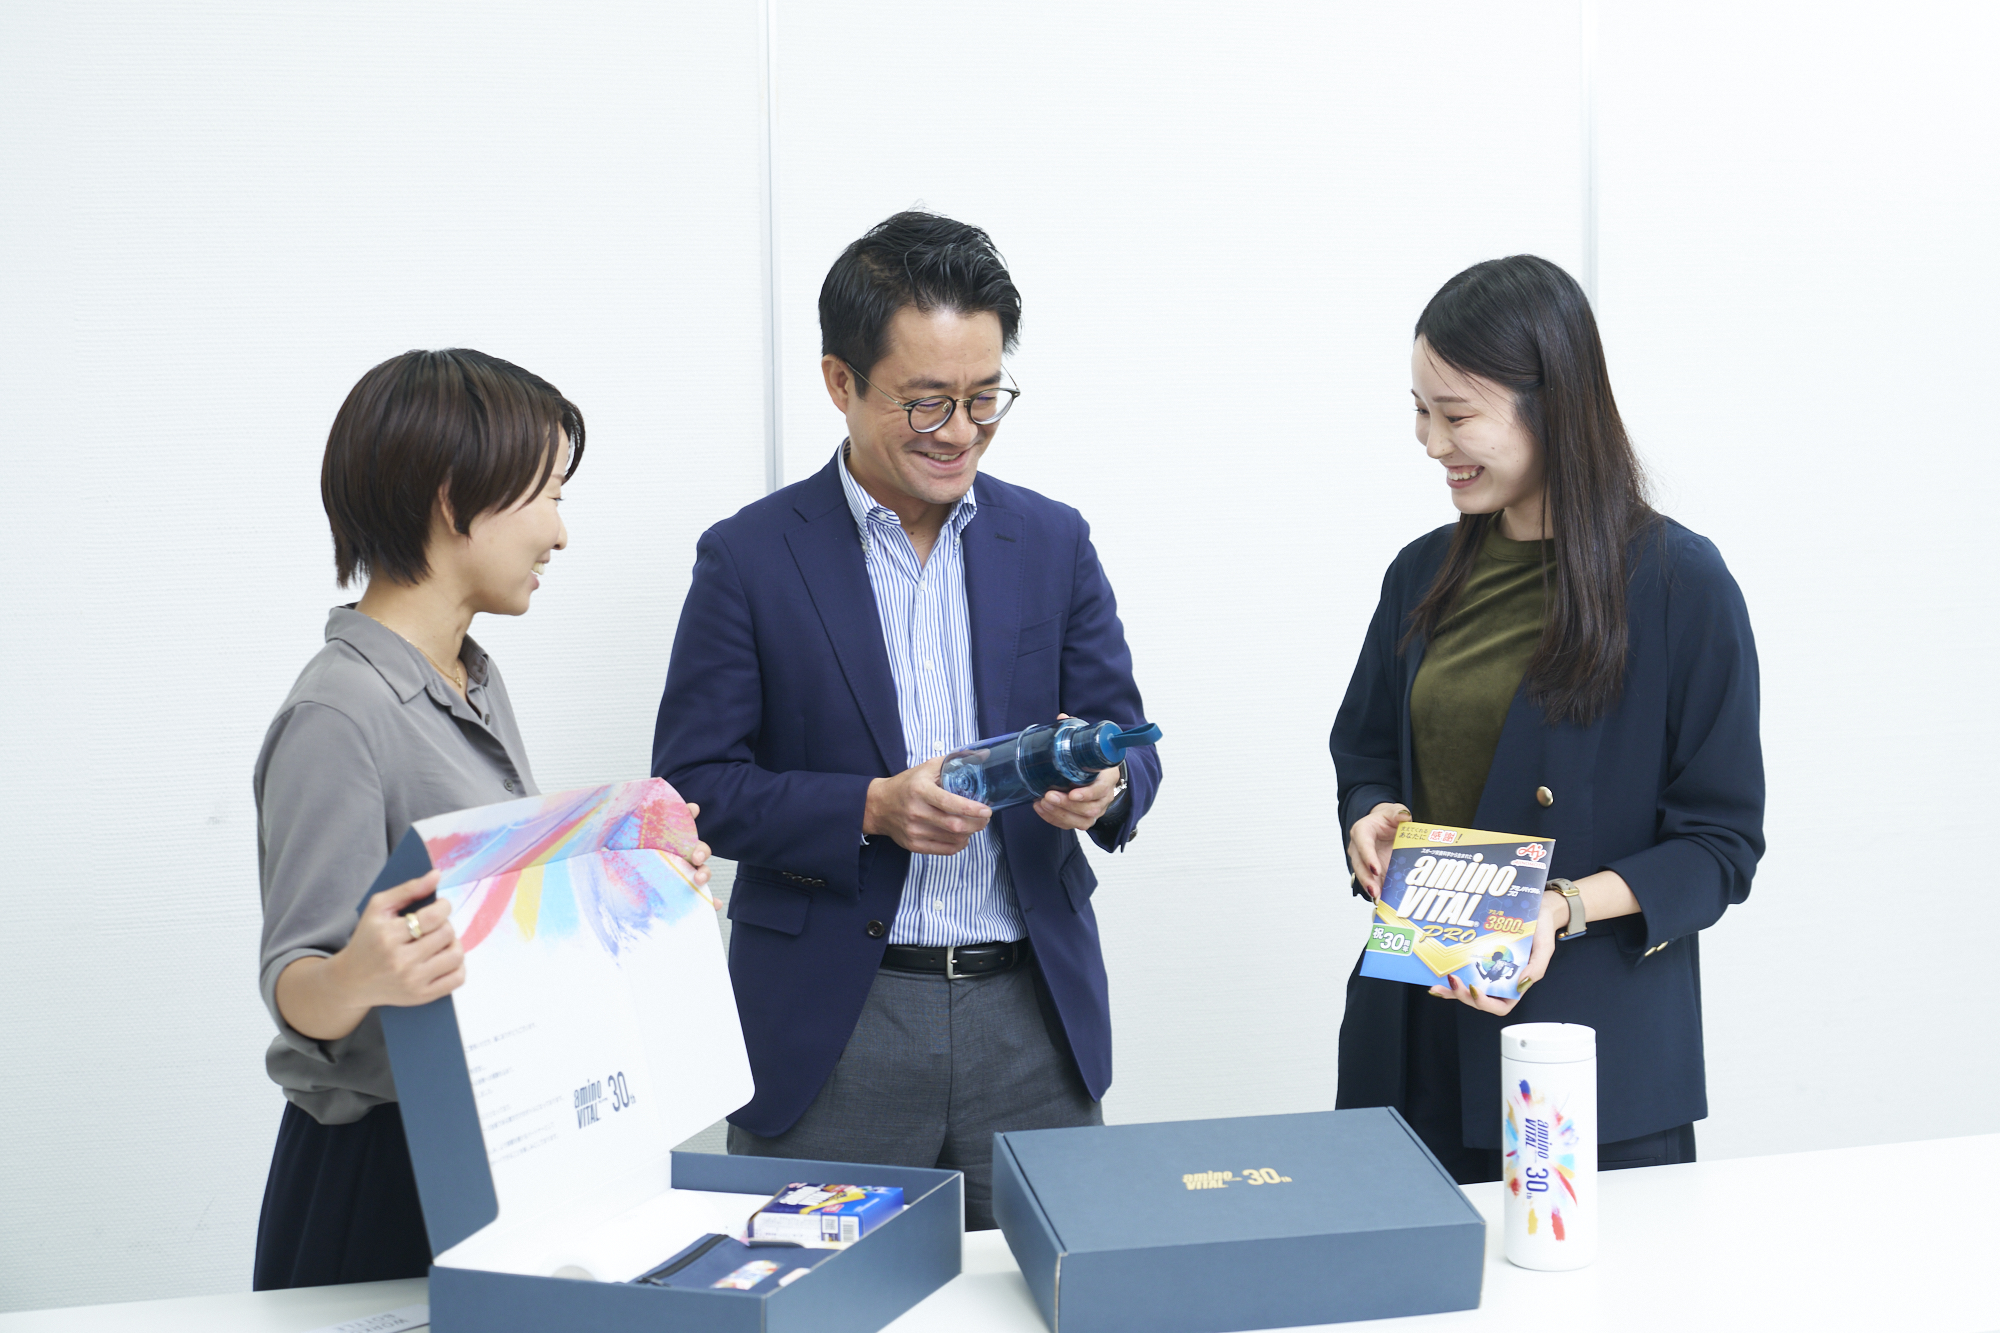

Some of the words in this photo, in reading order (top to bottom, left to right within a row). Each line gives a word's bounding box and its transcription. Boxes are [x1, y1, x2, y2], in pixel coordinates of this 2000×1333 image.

[1405, 852, 1518, 897] amino
[1419, 925, 1477, 943] PRO
[574, 1079, 602, 1109] amino
[577, 1102, 601, 1129] VITAL
[1525, 1118, 1537, 1147] VITAL
[1537, 1119, 1552, 1159] amino
[1182, 1170, 1233, 1183] amino
[1185, 1179, 1227, 1190] VITAL
